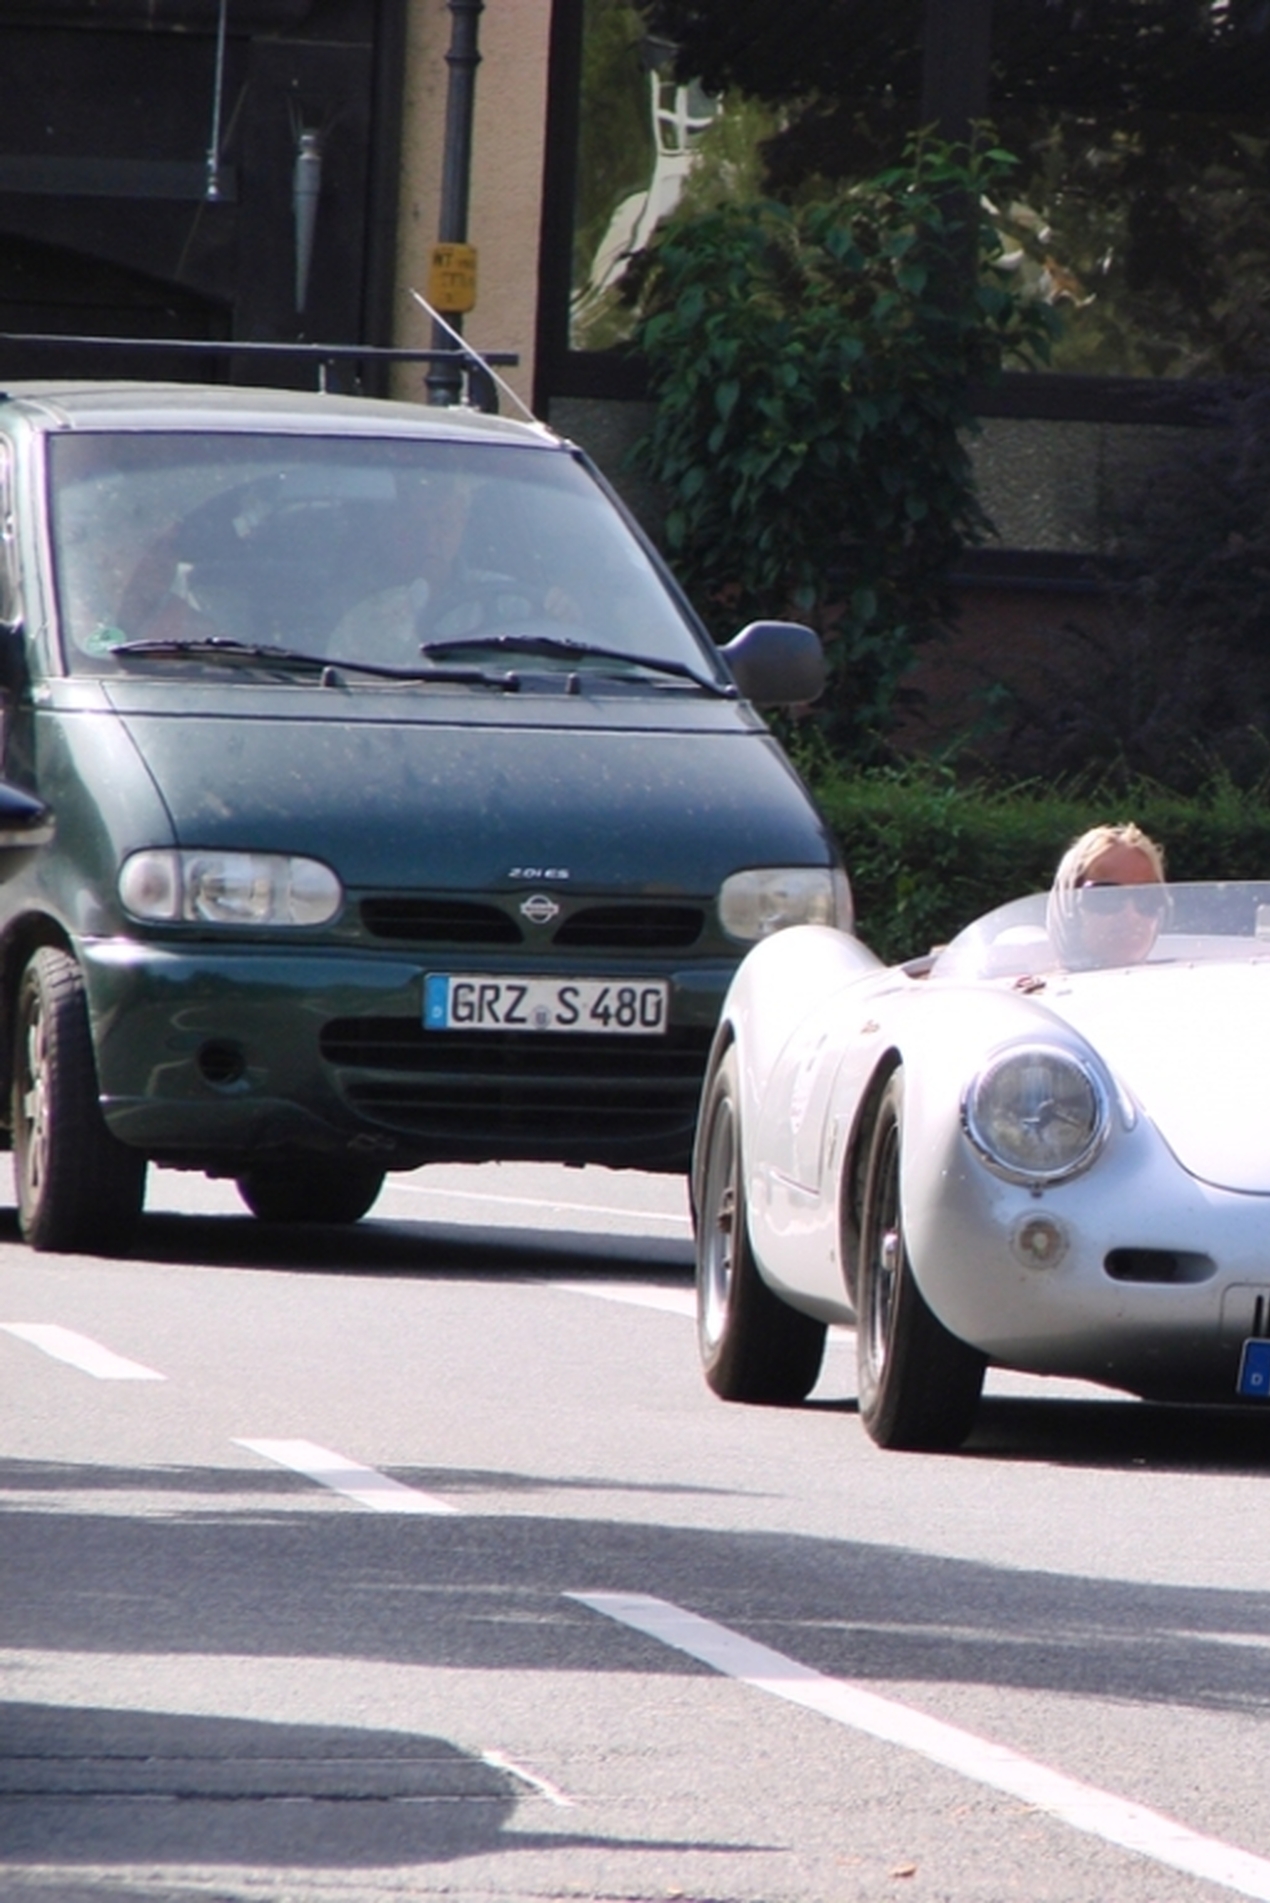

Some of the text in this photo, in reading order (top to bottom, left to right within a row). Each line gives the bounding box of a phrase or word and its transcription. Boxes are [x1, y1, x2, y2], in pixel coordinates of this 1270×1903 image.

[451, 983, 663, 1027] GRZ S 480
